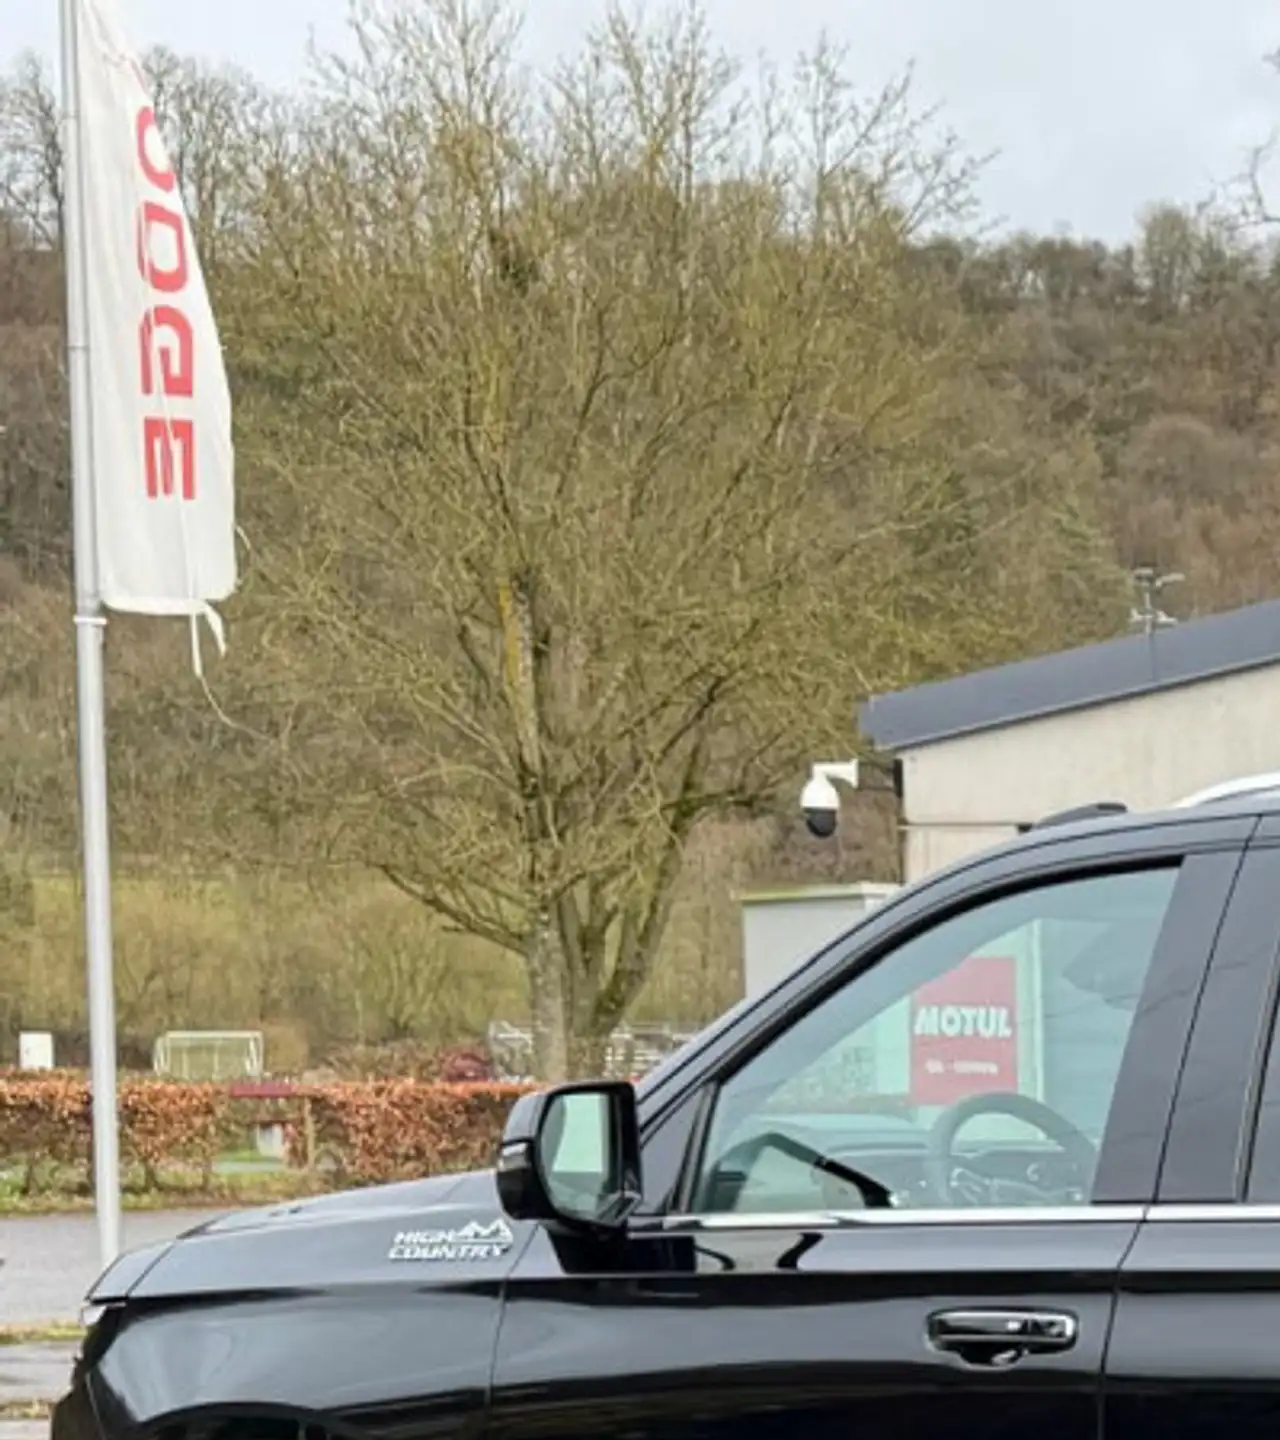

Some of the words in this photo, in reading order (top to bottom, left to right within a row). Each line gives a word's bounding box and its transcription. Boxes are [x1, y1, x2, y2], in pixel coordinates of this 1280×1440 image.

[135, 64, 195, 500] ODGE
[914, 1005, 1013, 1038] MOTUL
[394, 1230, 456, 1244] HIGH
[388, 1244, 505, 1259] COUNTRY
